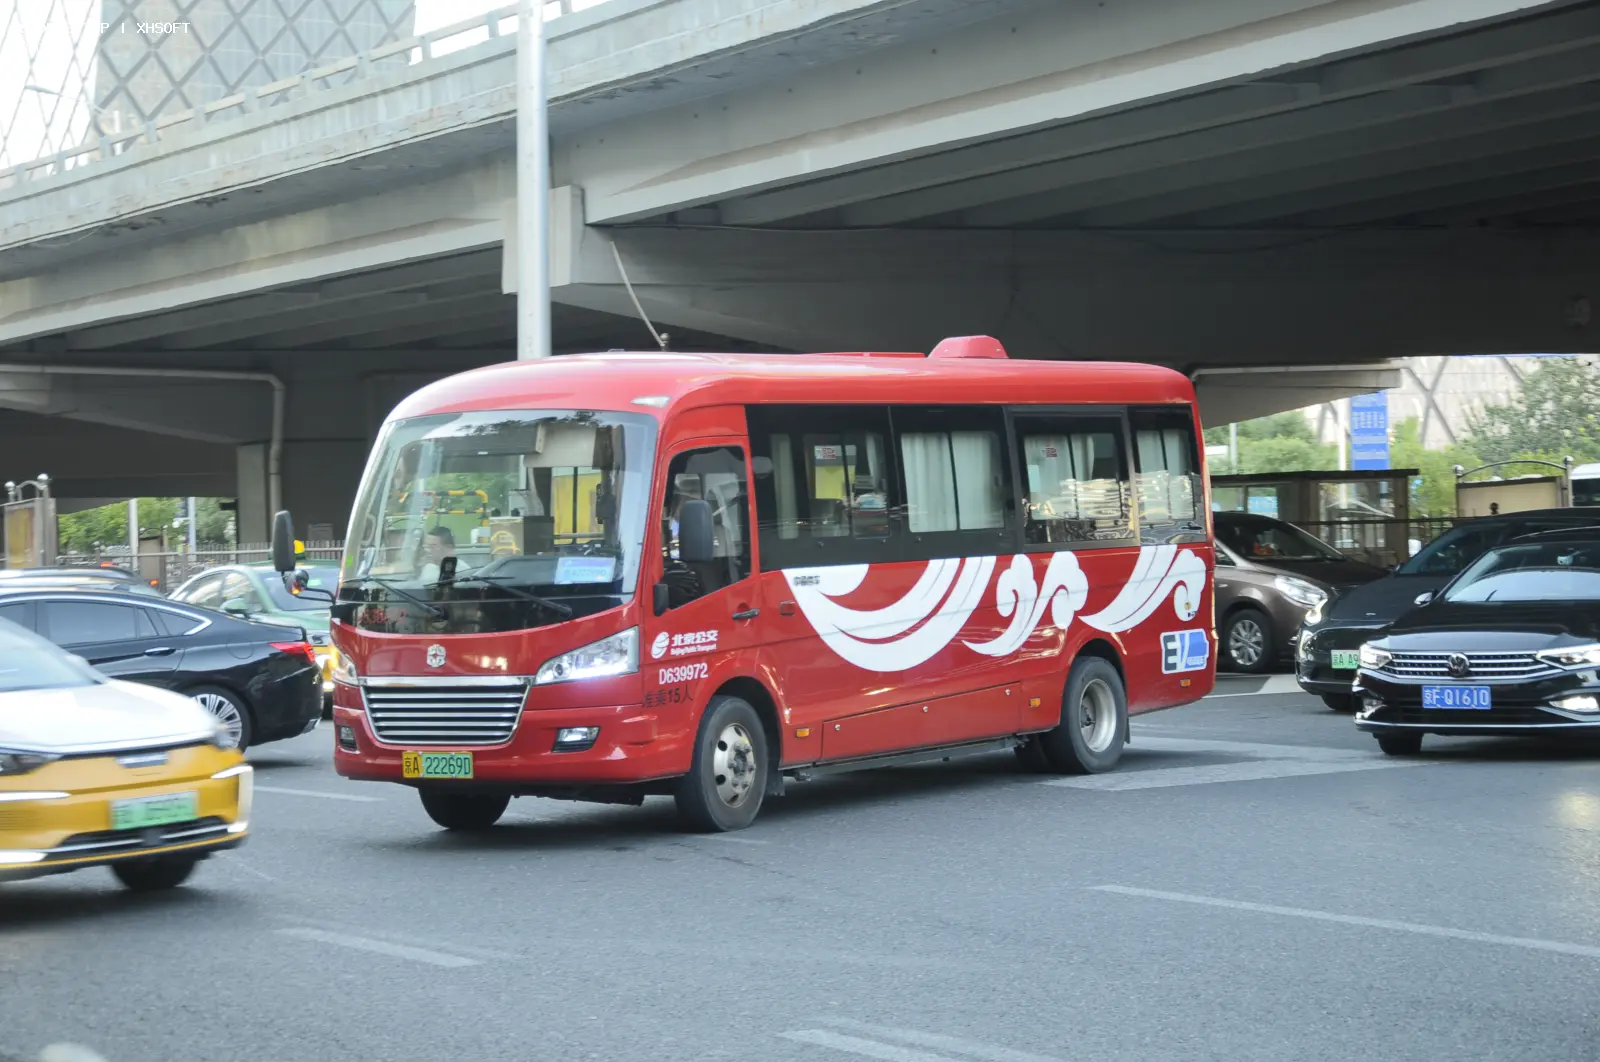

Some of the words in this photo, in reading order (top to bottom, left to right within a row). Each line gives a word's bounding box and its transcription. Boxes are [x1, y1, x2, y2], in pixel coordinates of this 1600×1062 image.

[671, 629, 719, 647] 北京公交
[658, 663, 708, 685] D639972
